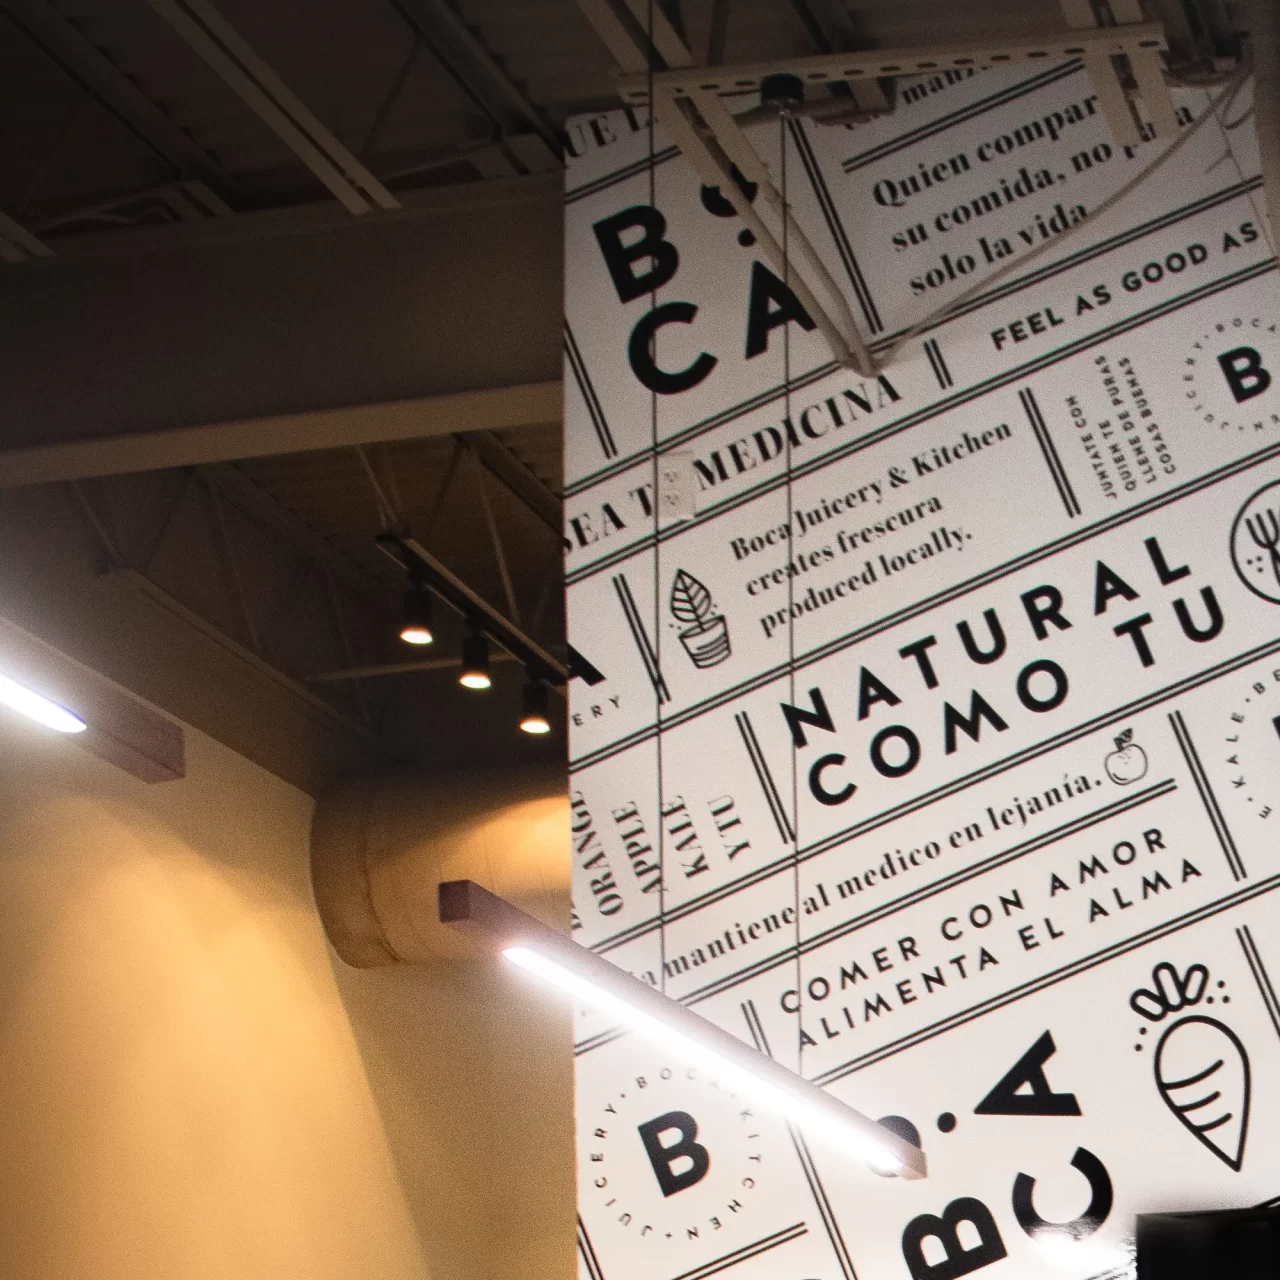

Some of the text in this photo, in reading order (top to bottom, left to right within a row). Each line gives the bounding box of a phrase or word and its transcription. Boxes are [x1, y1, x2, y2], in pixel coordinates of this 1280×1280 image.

[873, 150, 971, 208] Quien
[891, 222, 928, 251] su
[934, 166, 1065, 233] comida,
[1070, 143, 1113, 173] no
[909, 203, 1089, 297] solo la vida
[991, 222, 1259, 352] FEEL AS GOOD AS
[1094, 355, 1157, 484] LLENE DE PURAS
[1117, 357, 1177, 475] COSAS BUENAS
[1217, 346, 1272, 404] B
[692, 376, 903, 492] MEDICINA
[1064, 395, 1118, 500] JUNTATE CON
[1097, 419, 1137, 492] QUIEN TE
[729, 422, 1012, 561] Boca Juicery & Kitchen
[746, 494, 943, 597] creates frescura
[759, 525, 974, 638] produced locally.
[779, 536, 1191, 749] NATURAL
[808, 585, 1225, 806] COMO TU
[1225, 711, 1247, 790] KALE
[611, 800, 668, 894] APPLE
[660, 795, 710, 879] KALE
[664, 772, 1103, 979] mantiene al medico en lejanía.
[708, 794, 752, 861] Y TU
[780, 828, 1167, 1015] COMER CON AMOR
[799, 857, 1204, 1053] ALIMENTA EL ALMA
[637, 1110, 712, 1199] B
